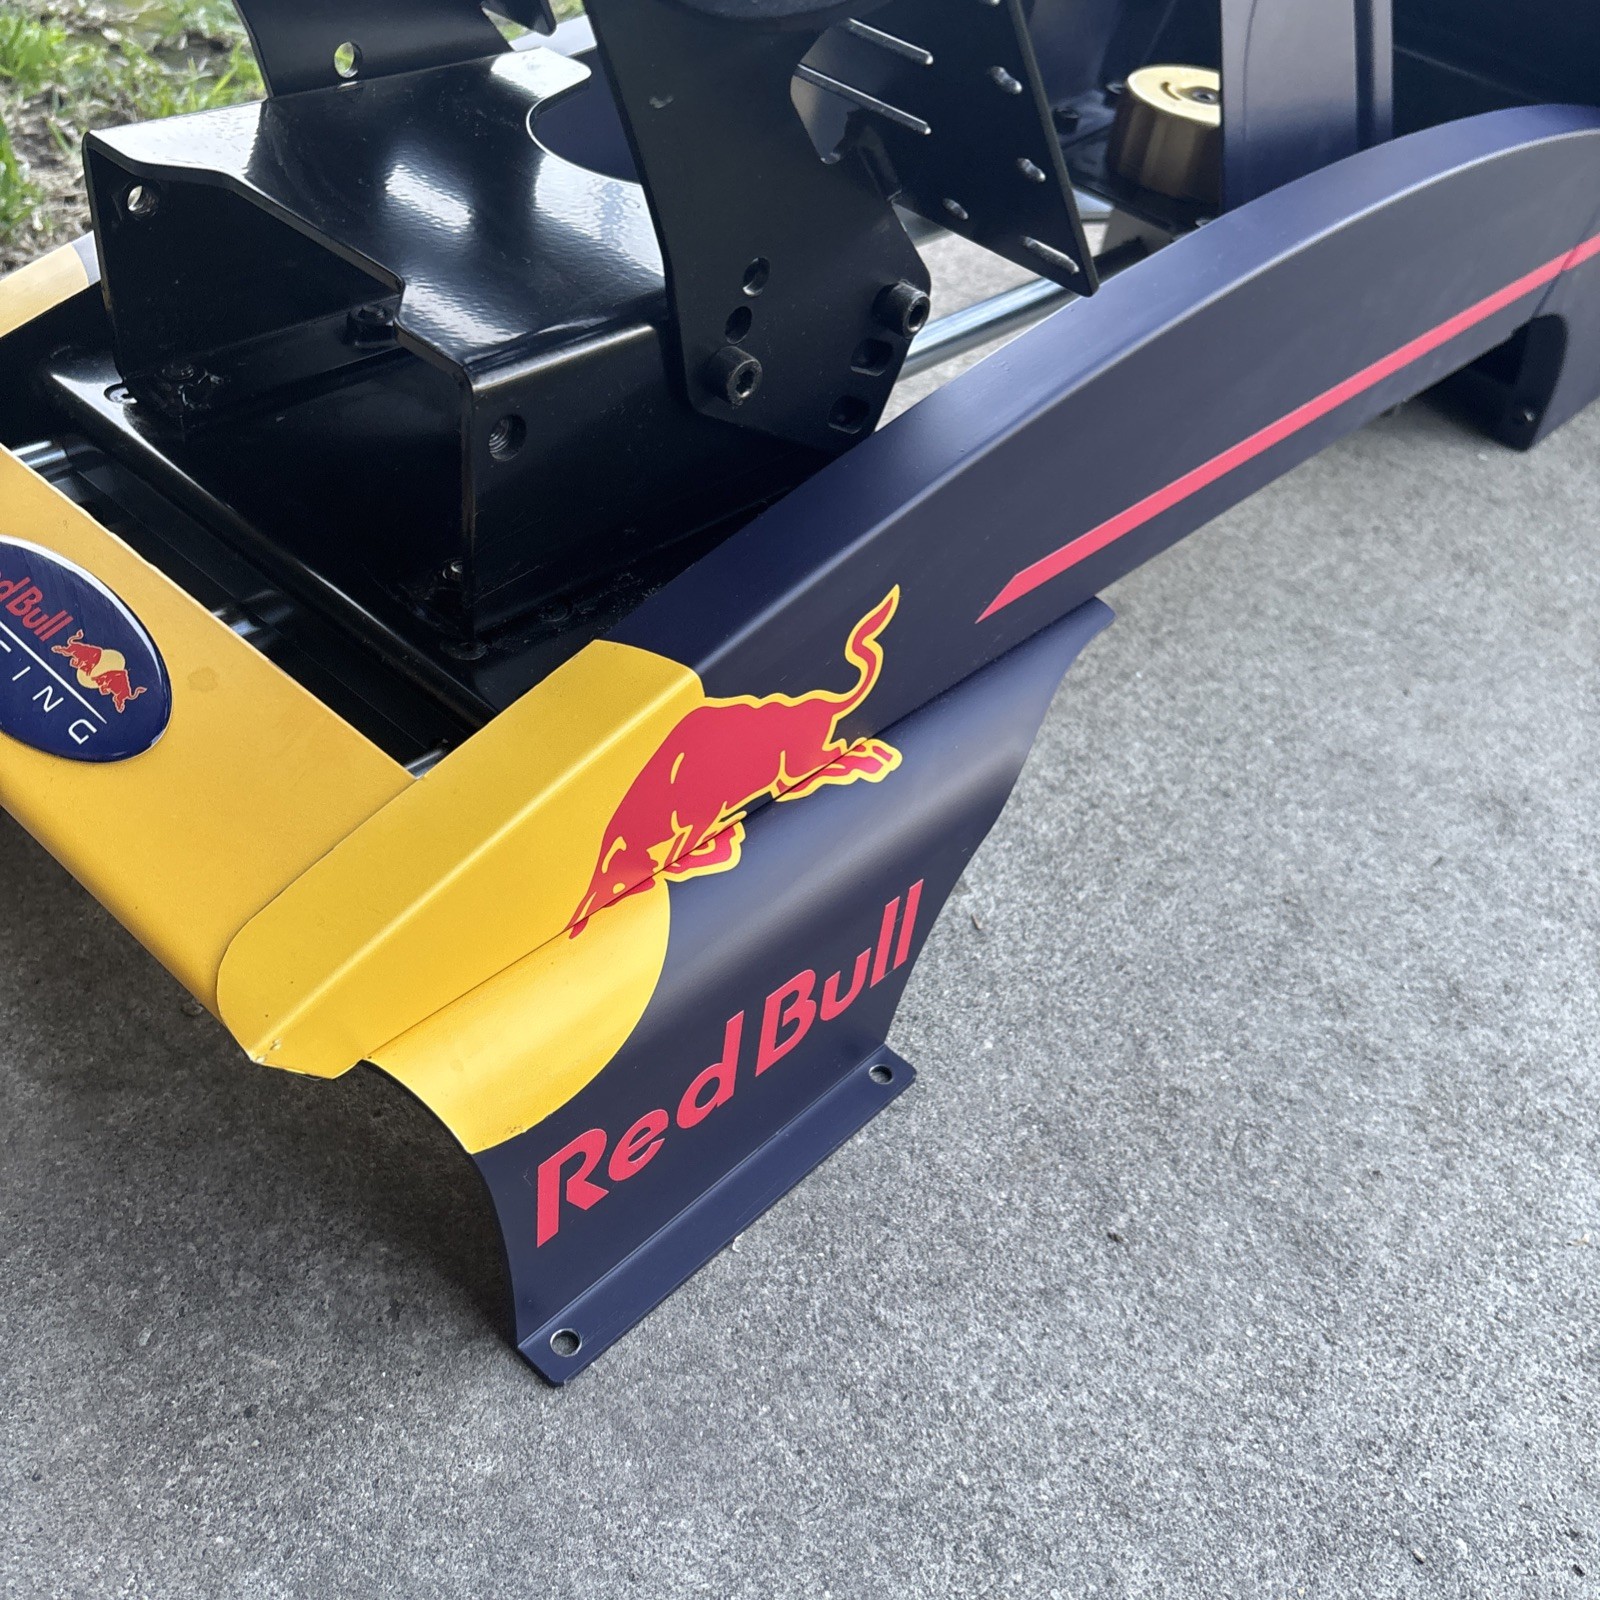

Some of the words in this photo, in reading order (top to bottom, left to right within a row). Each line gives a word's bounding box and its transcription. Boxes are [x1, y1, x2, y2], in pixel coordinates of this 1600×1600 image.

[0, 572, 31, 602] d
[5, 577, 73, 641] Bull
[0, 640, 97, 745] ING
[537, 1010, 744, 1248] Red
[755, 879, 924, 1077] Bull
